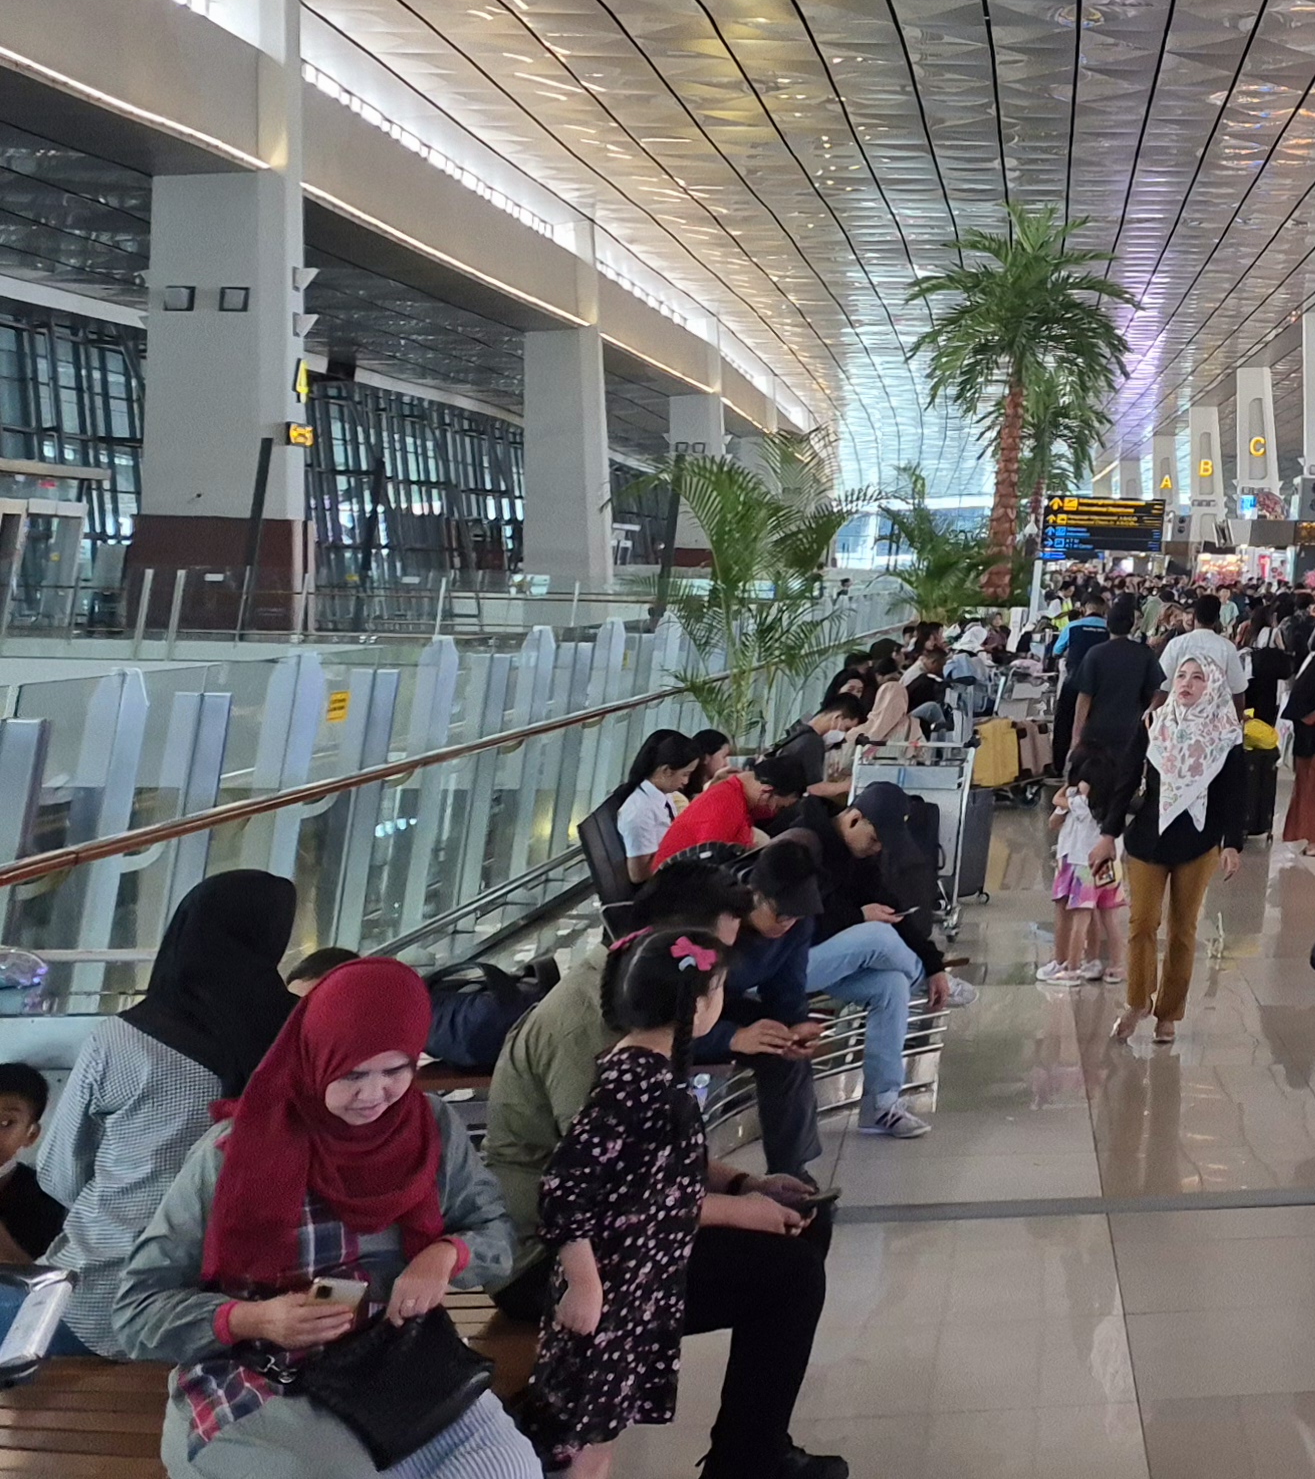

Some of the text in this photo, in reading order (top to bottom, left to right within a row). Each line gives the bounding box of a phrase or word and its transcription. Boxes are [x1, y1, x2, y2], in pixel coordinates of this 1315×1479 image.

[1249, 436, 1266, 457] C
[1199, 459, 1213, 477] B
[1160, 474, 1172, 489] A
